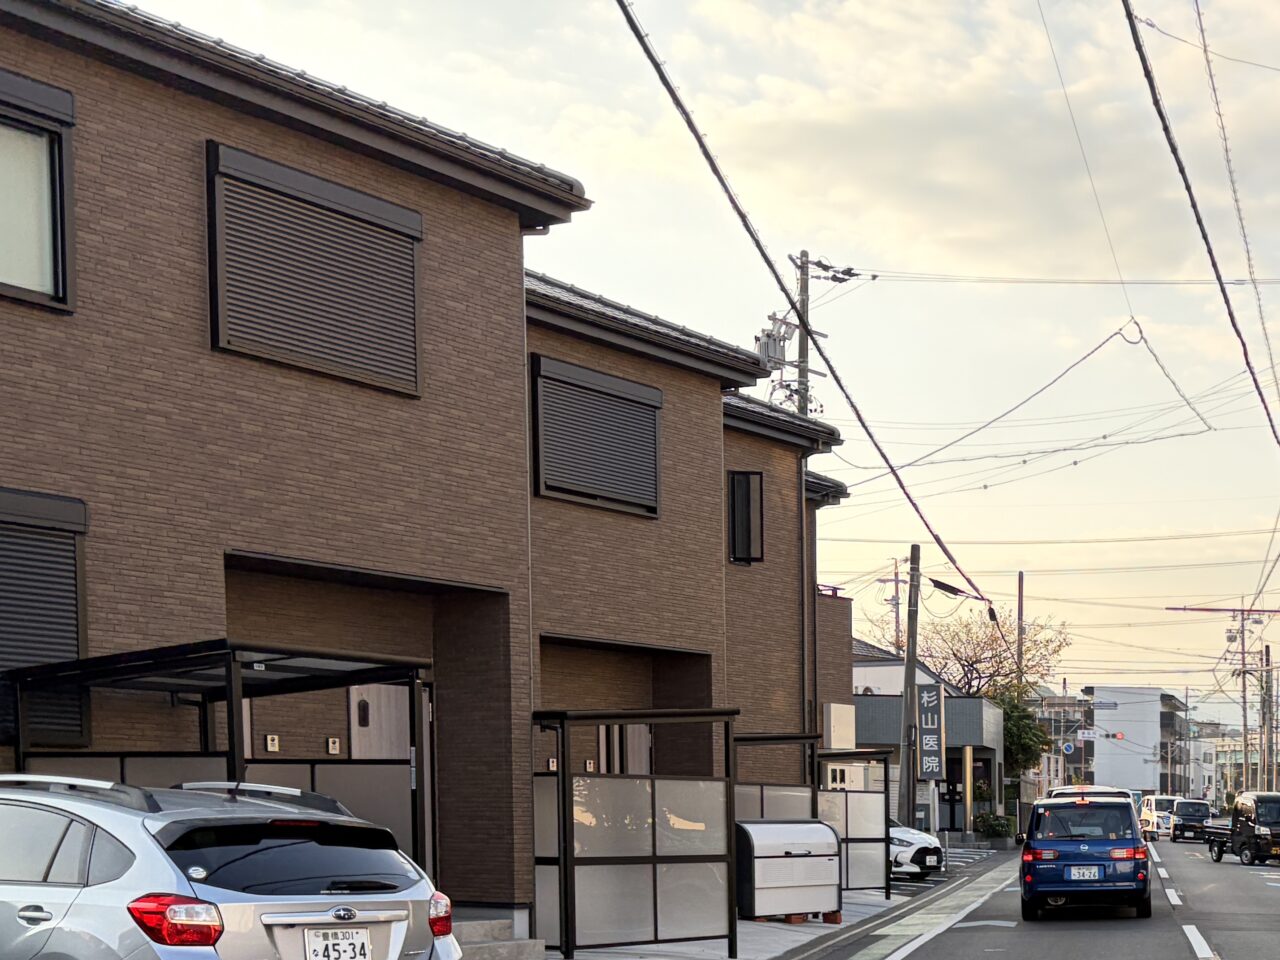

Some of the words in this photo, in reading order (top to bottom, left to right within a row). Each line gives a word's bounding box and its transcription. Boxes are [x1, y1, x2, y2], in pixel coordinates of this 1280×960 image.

[921, 690, 939, 772] 杉山医院
[340, 931, 354, 940] 301
[322, 942, 367, 960] 45-34
